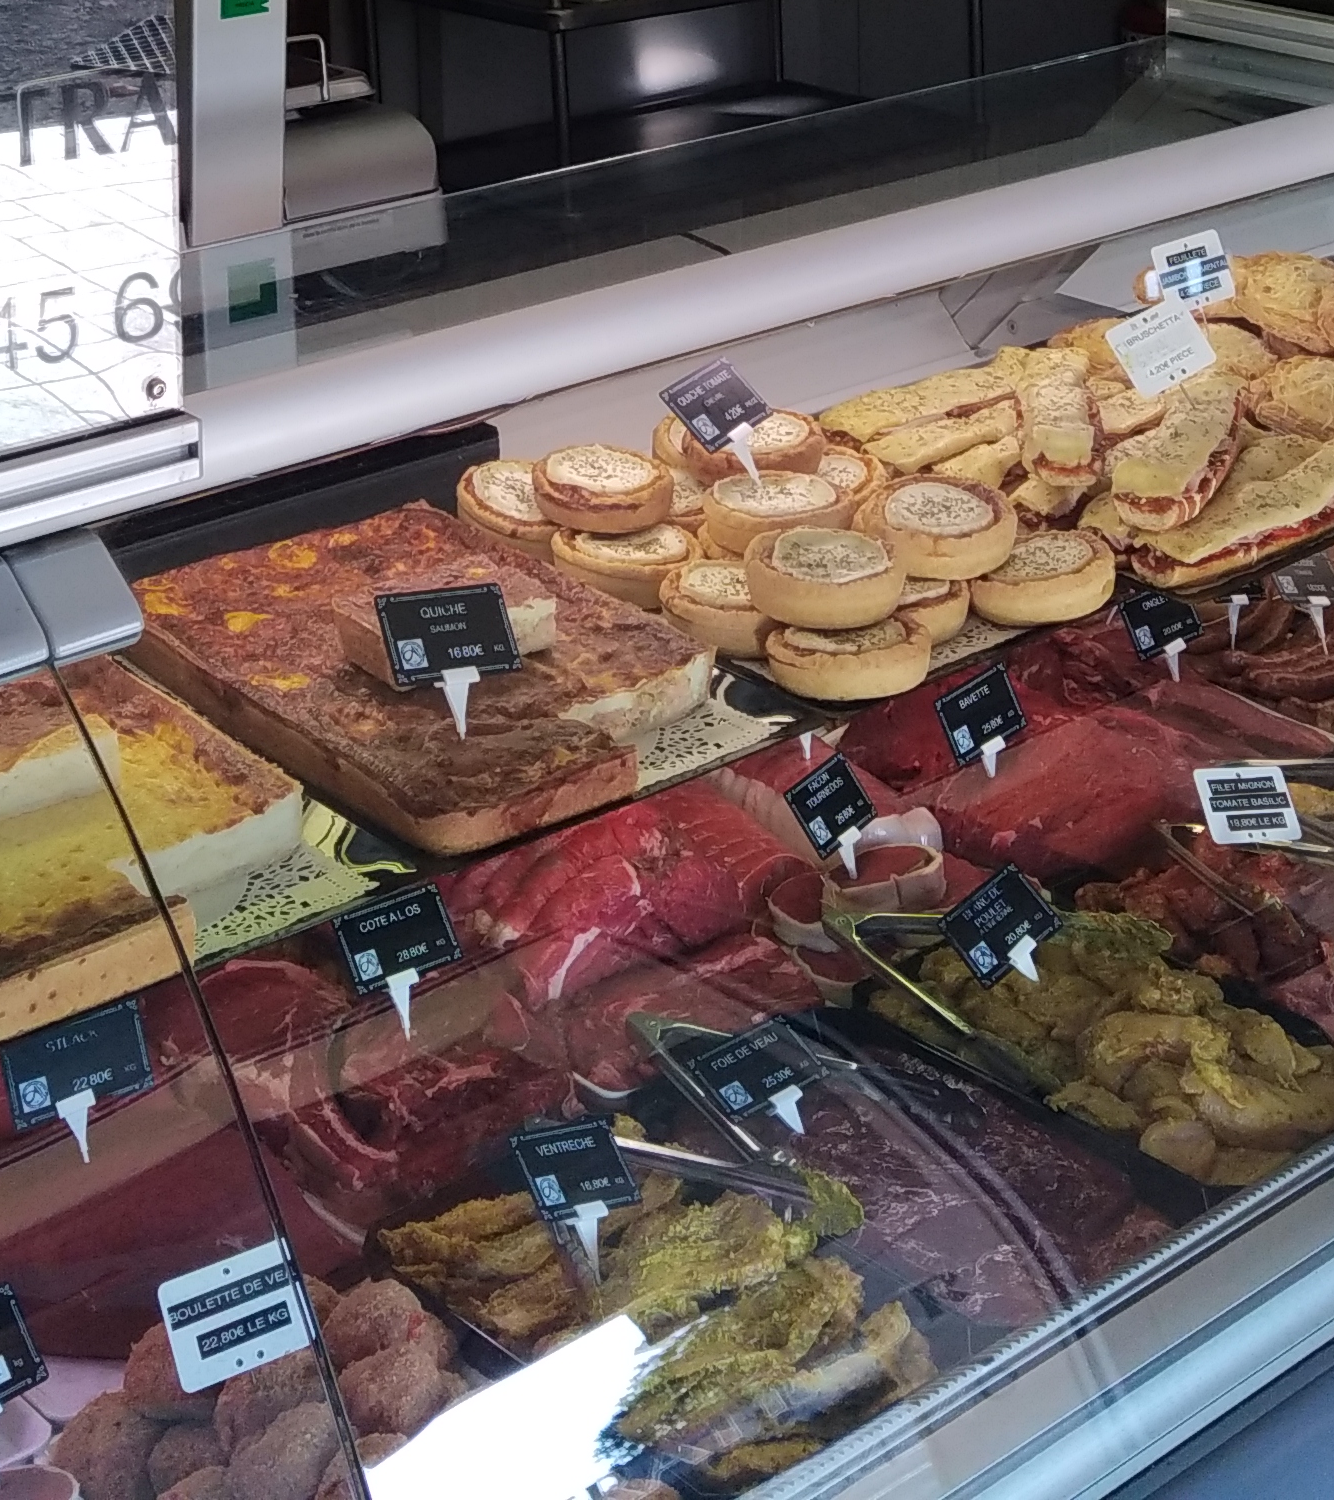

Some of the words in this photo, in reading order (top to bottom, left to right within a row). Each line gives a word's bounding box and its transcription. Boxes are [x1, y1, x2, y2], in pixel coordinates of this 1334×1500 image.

[1168, 248, 1207, 264] FEUILLETE
[1125, 313, 1182, 347] BRUSCHETTA
[1169, 346, 1195, 366] PIECE
[676, 385, 706, 407] QUICHE
[702, 369, 732, 391] TOMATE
[419, 602, 468, 619] QUICHE
[1141, 595, 1169, 612] ONGLE
[429, 621, 467, 634] SAUMON
[958, 683, 991, 710] BAVETTE
[805, 775, 845, 810] TOURNEDOS
[1210, 782, 1236, 792] FILET
[1210, 797, 1250, 809] TOMATE
[1251, 795, 1287, 807] BASILIC
[1259, 816, 1270, 827] LE
[1271, 815, 1287, 825] KG
[359, 913, 390, 934] COTE
[972, 897, 1008, 929] POULET
[710, 1051, 736, 1072] FOIE
[733, 1043, 753, 1060] DE
[749, 1031, 780, 1052] VEAU
[534, 1135, 598, 1157] VENTRECHE
[169, 1286, 242, 1325] BOULETTE
[242, 1277, 264, 1296] DE
[201, 1324, 247, 1352] 22,80€
[247, 1316, 267, 1334] LE
[267, 1307, 289, 1325] KG
